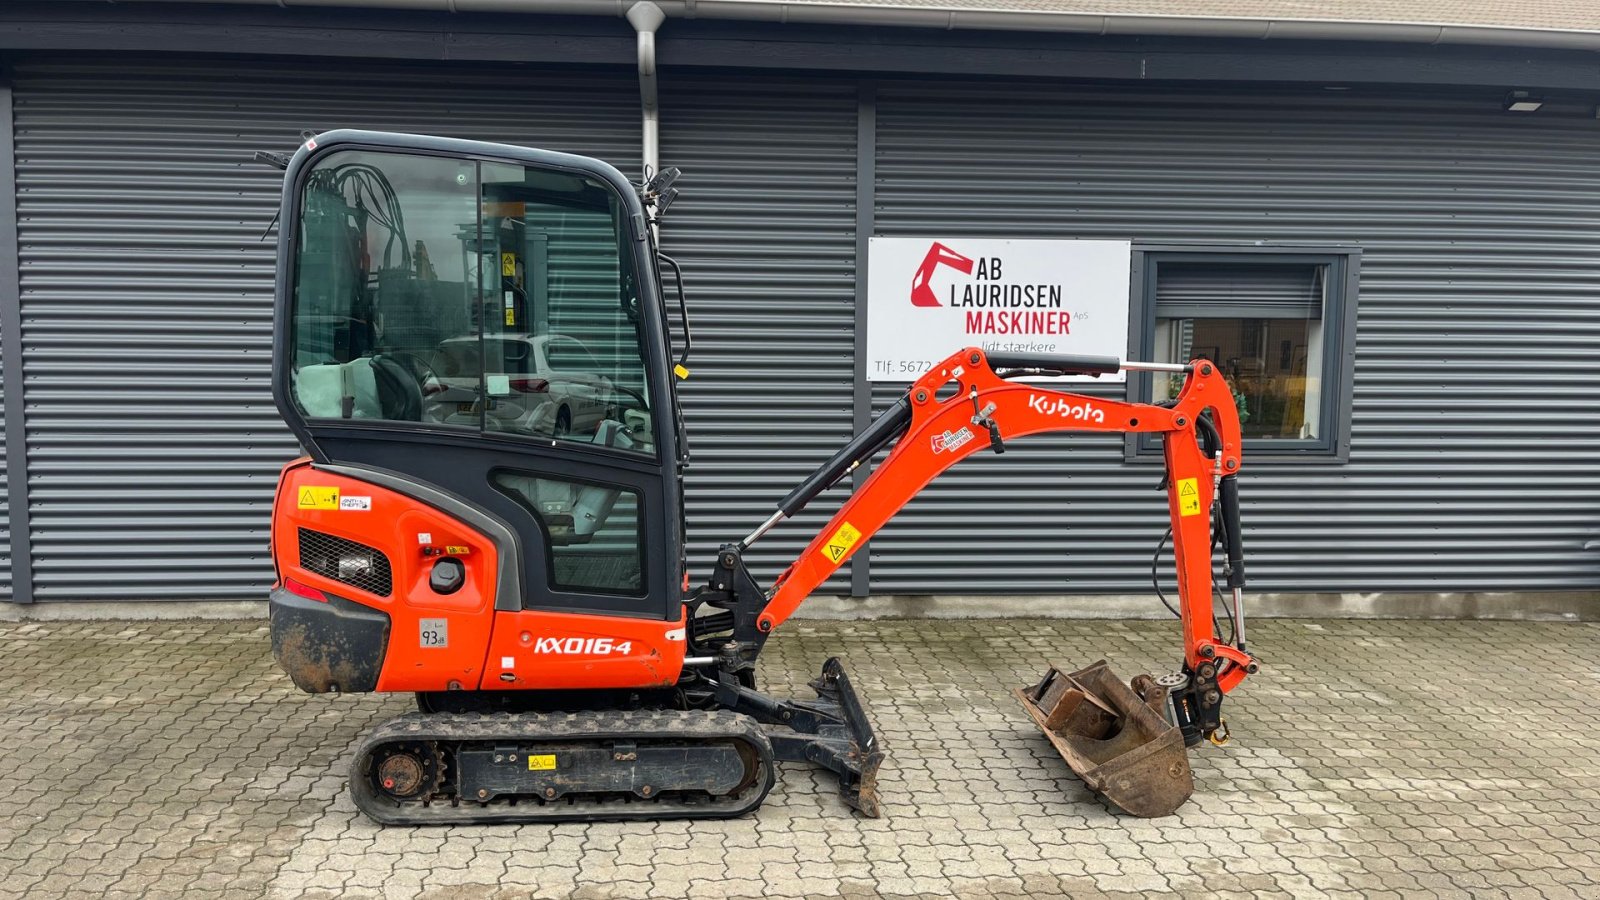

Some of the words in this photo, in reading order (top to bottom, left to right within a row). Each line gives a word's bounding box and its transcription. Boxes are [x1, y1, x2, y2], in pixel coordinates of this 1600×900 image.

[976, 257, 1002, 280] AB
[950, 284, 1062, 307] LAURIDSEN
[966, 311, 1071, 335] MASKINER
[1073, 311, 1089, 320] ApS
[1003, 341, 1056, 352] stærkere
[875, 360, 895, 375] Tlf.
[900, 361, 932, 373] 5672
[1028, 394, 1104, 423] Kubota
[422, 631, 437, 644] 93
